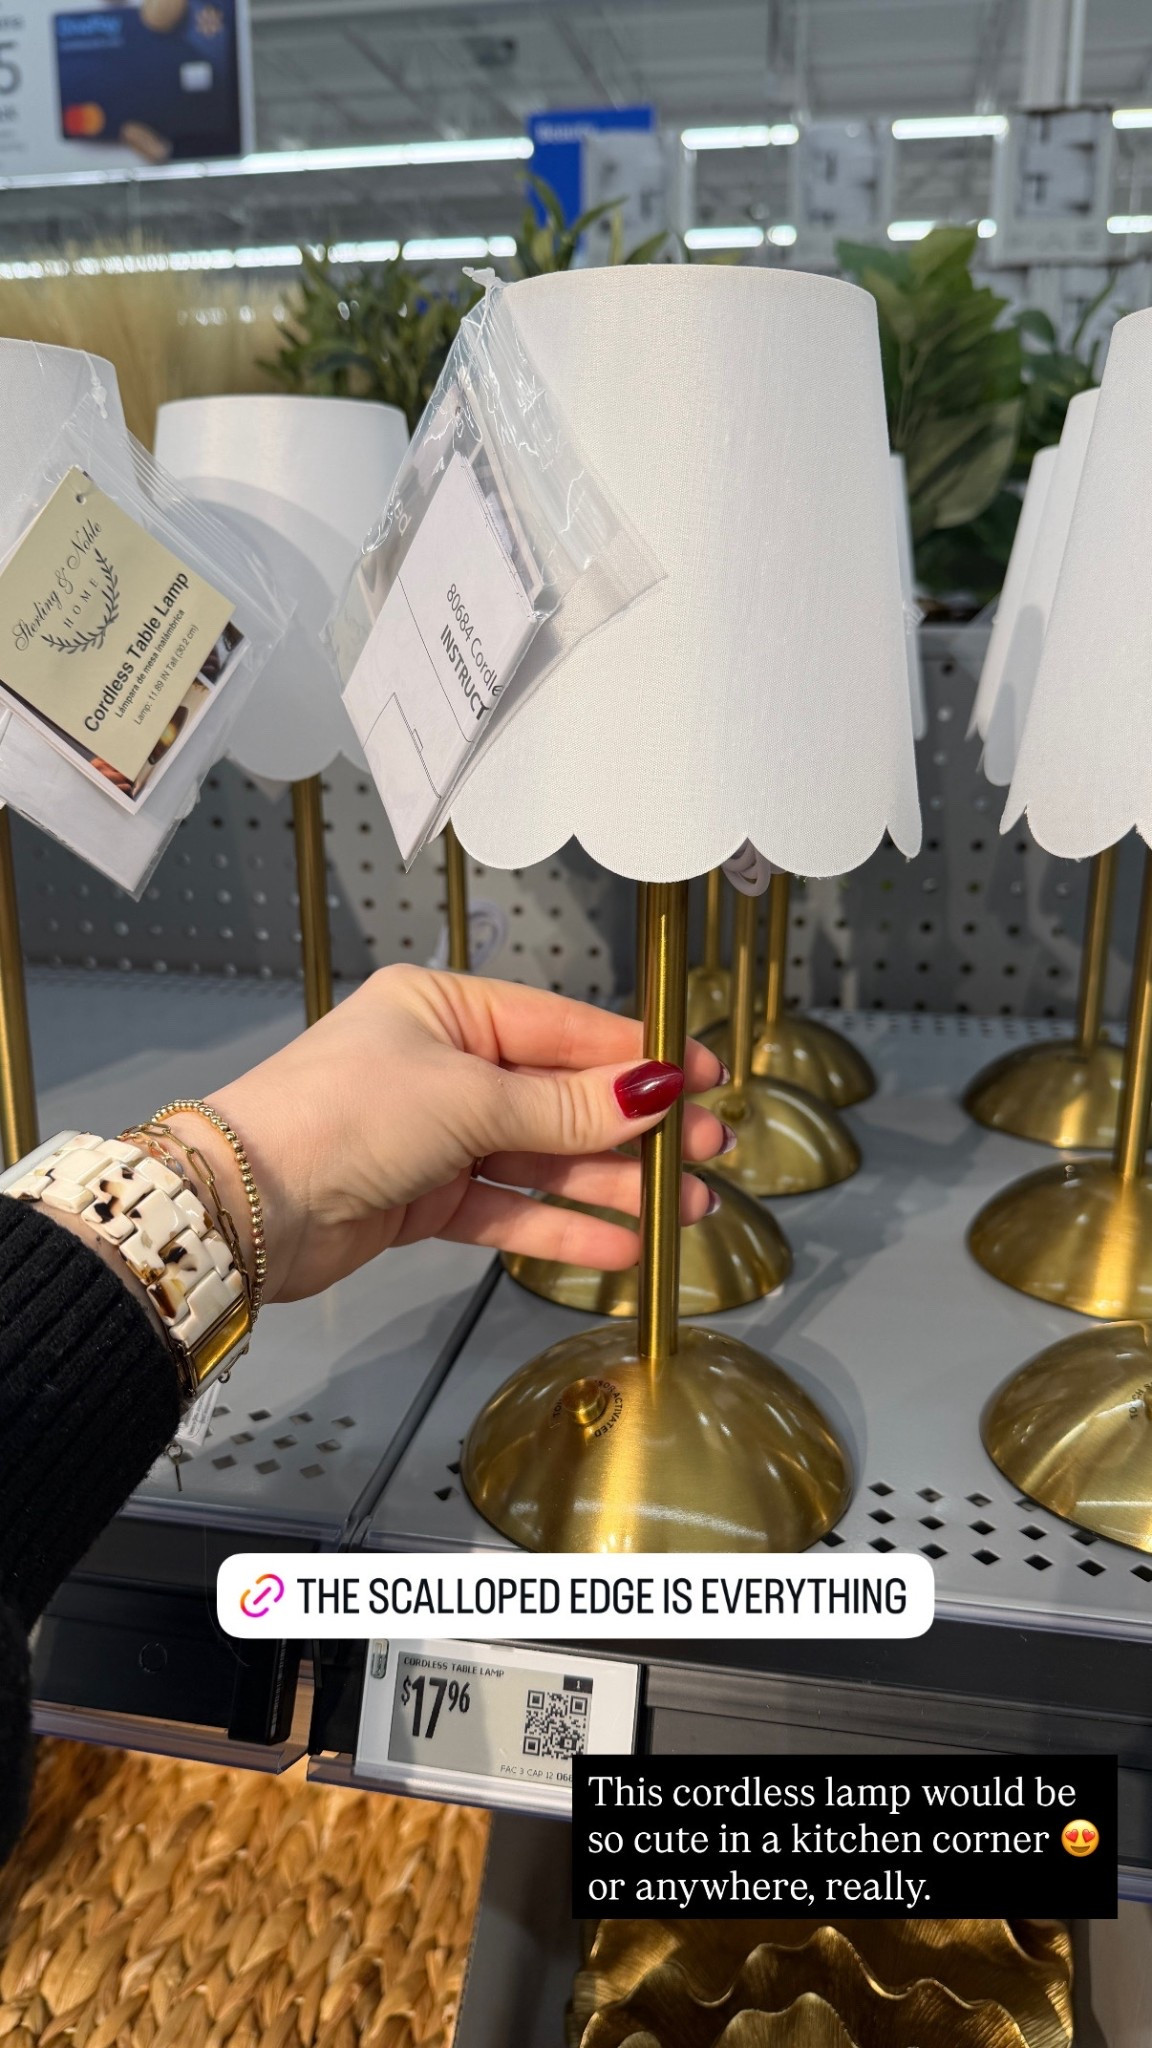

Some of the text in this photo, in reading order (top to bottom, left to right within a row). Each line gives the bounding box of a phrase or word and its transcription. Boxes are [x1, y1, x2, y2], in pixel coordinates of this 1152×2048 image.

[12, 519, 101, 651] Sterling & Noble
[447, 583, 474, 642] 80684
[84, 572, 189, 732] Cordless Table Lamp
[115, 685, 140, 718] Lámpara
[137, 673, 147, 685] de
[144, 653, 159, 674] mesa
[134, 701, 153, 725] Lamp:
[148, 681, 165, 701] 11.89
[161, 671, 170, 682] IN
[166, 657, 178, 671] Tall
[187, 624, 200, 640] cm)
[404, 1656, 505, 1678] CORDLESS TABLE LAMP
